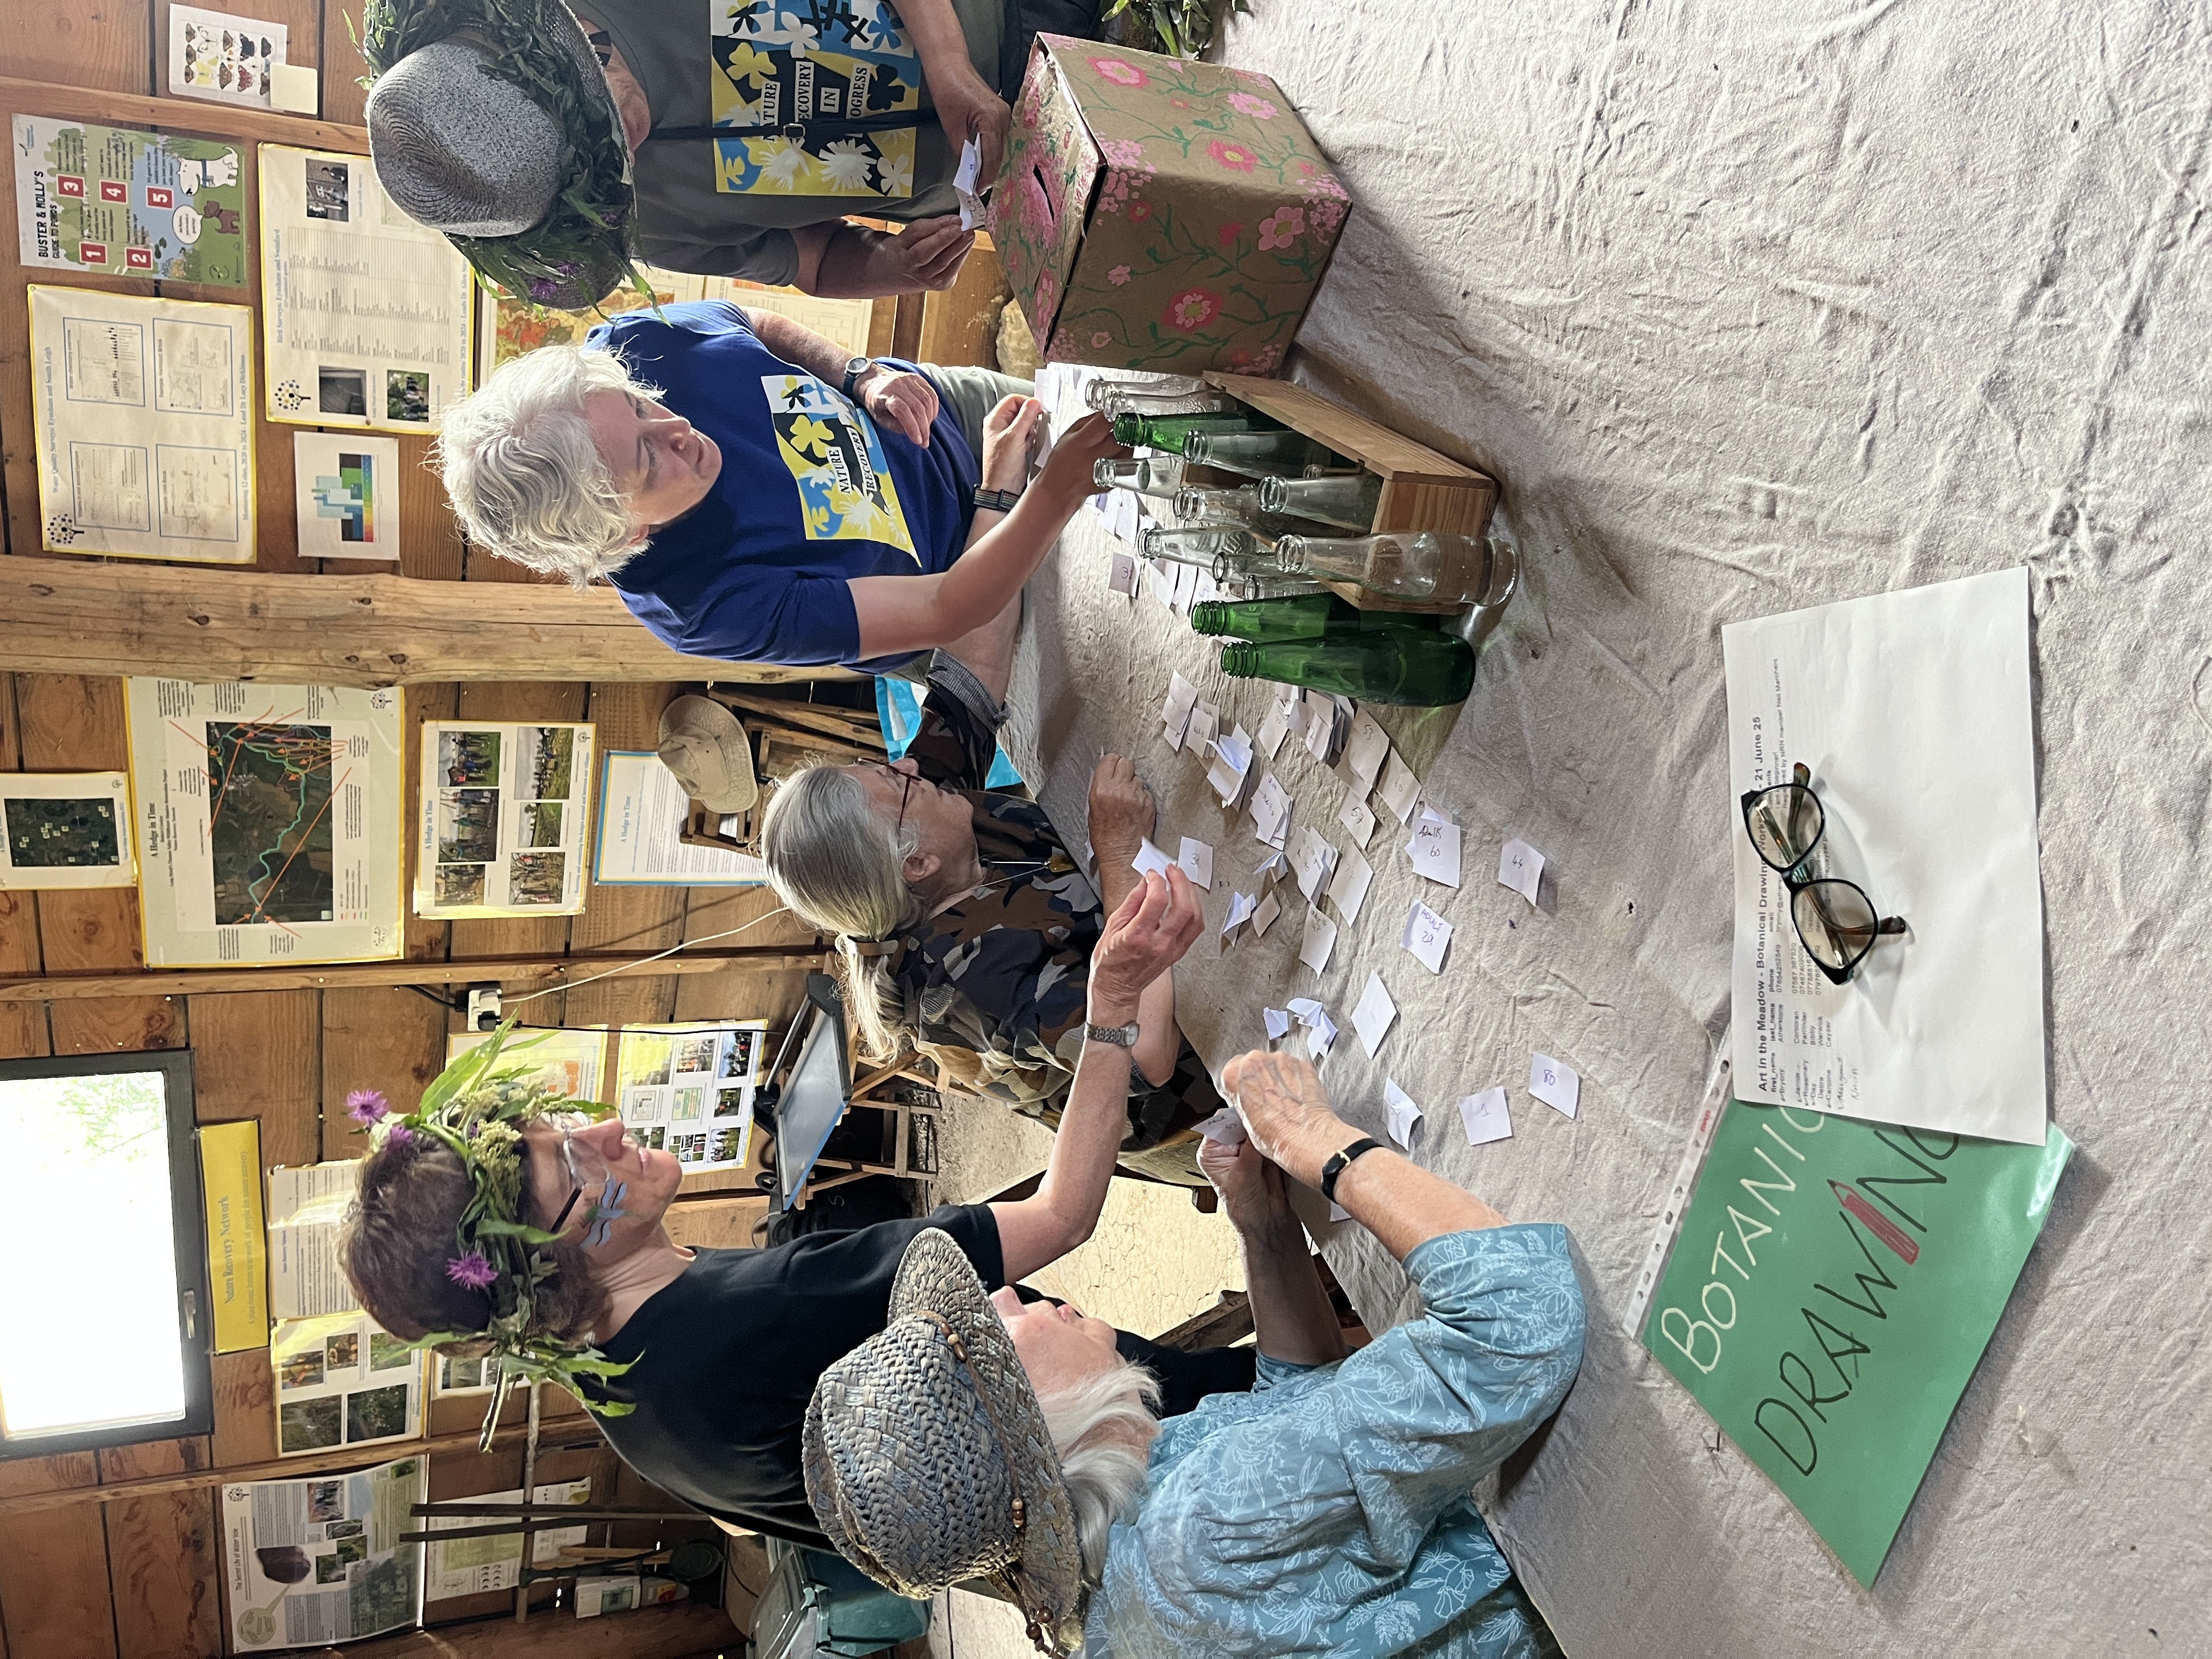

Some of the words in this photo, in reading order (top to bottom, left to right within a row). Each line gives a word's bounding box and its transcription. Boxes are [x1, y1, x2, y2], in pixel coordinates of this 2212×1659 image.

[798, 64, 811, 121] ECOVERY
[824, 91, 836, 108] IN
[850, 67, 867, 117] OGRESS
[34, 171, 46, 208] MOLLY'S
[64, 182, 78, 191] 3
[106, 188, 122, 197] 4
[153, 193, 167, 202] 5
[50, 205, 58, 227] PONDS
[37, 221, 48, 257] BUSTER
[51, 228, 59, 236] TO
[52, 239, 60, 258] GUIDE
[132, 253, 146, 263] 2
[849, 428, 875, 490] RECOVERY
[829, 450, 850, 494] NATURE
[1773, 658, 1781, 691] Marchant
[1753, 717, 1762, 730] 25
[1776, 709, 1785, 738] member
[1755, 734, 1763, 763] June
[1754, 769, 1763, 781] 21
[148, 803, 156, 821] Time
[425, 825, 433, 844] Hedge
[621, 819, 630, 837] Hedge
[150, 830, 159, 851] Hedge
[1512, 855, 1522, 869] 44
[1759, 861, 1768, 907] Drawin
[1420, 909, 1443, 932] ADULT
[1756, 912, 1766, 968] Botanical
[1757, 980, 1767, 1030] Meadow
[1758, 1035, 1767, 1053] the
[1758, 1058, 1767, 1069] in
[1758, 1073, 1767, 1091] Art
[218, 1195, 230, 1237] Network
